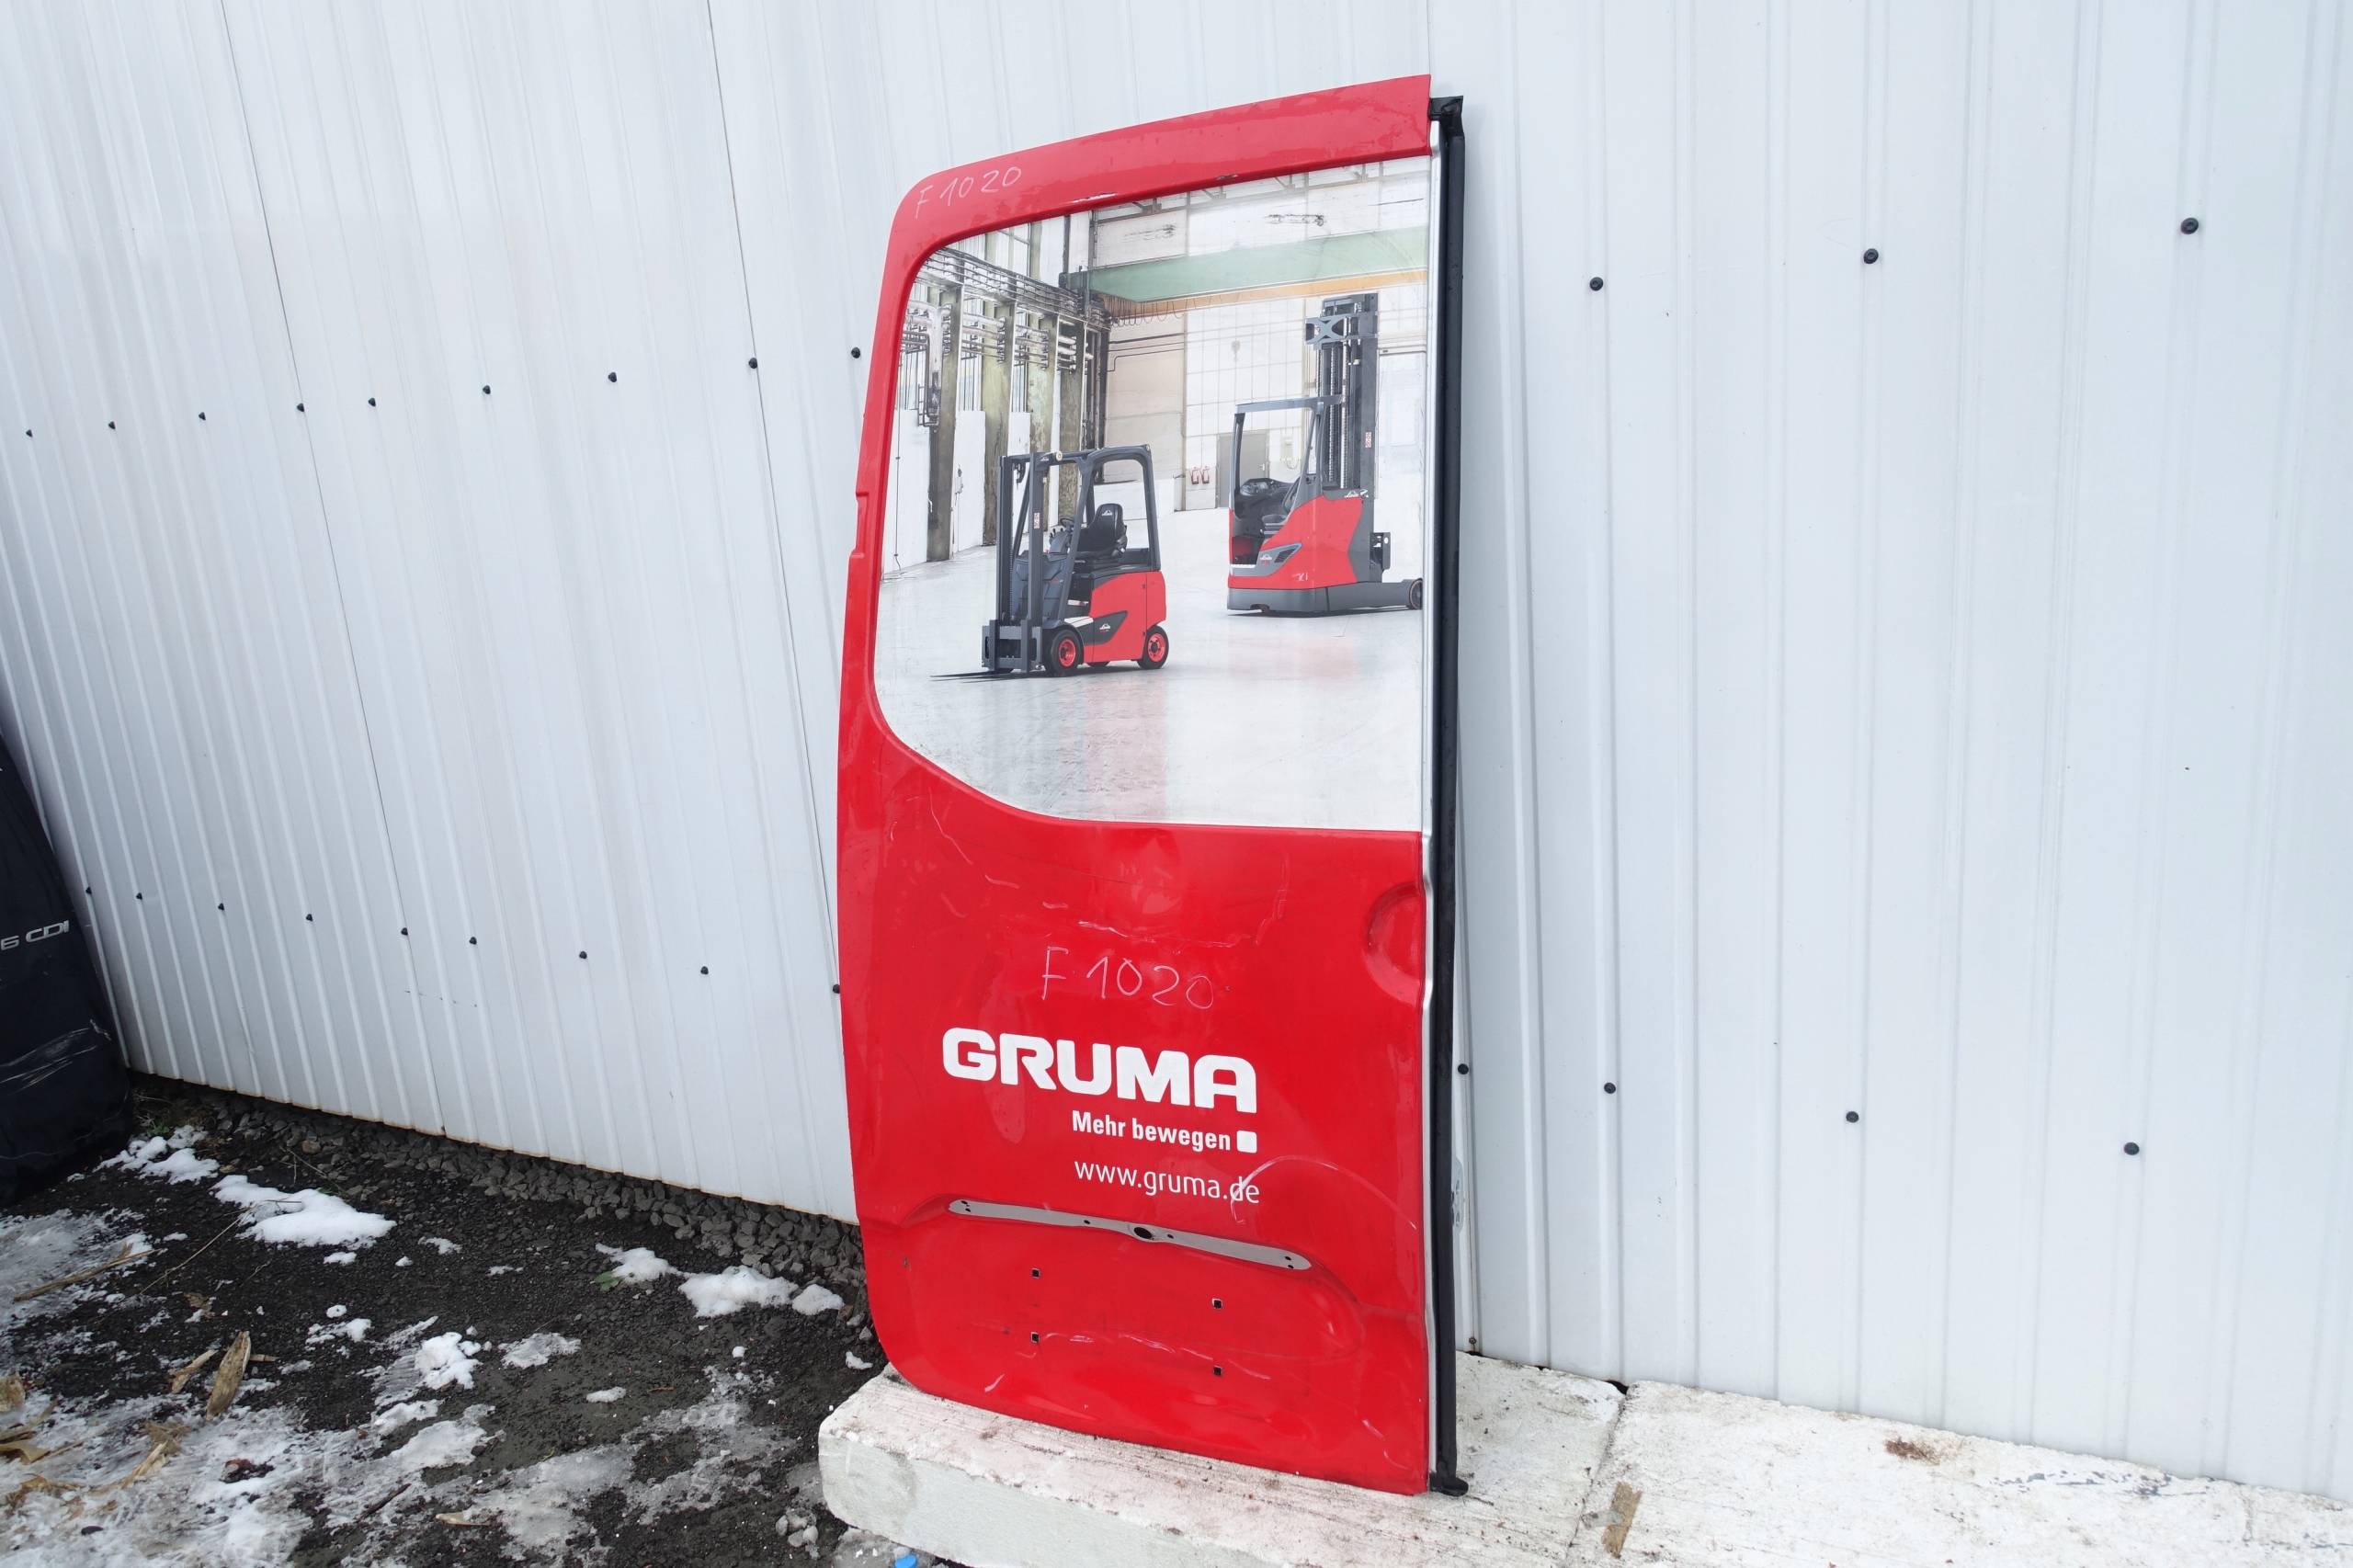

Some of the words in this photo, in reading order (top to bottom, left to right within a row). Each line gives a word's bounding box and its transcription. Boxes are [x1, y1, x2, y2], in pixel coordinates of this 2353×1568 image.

[915, 184, 933, 219] F
[0, 935, 20, 950] 6
[25, 920, 70, 943] CDI
[1041, 946, 1069, 1001] F
[1086, 955, 1214, 1010] 1020
[942, 1027, 1256, 1114] GRUMA
[1072, 1109, 1126, 1138] Mehr
[1131, 1117, 1231, 1152] bewegen
[1074, 1160, 1260, 1204] www.gruma.de
